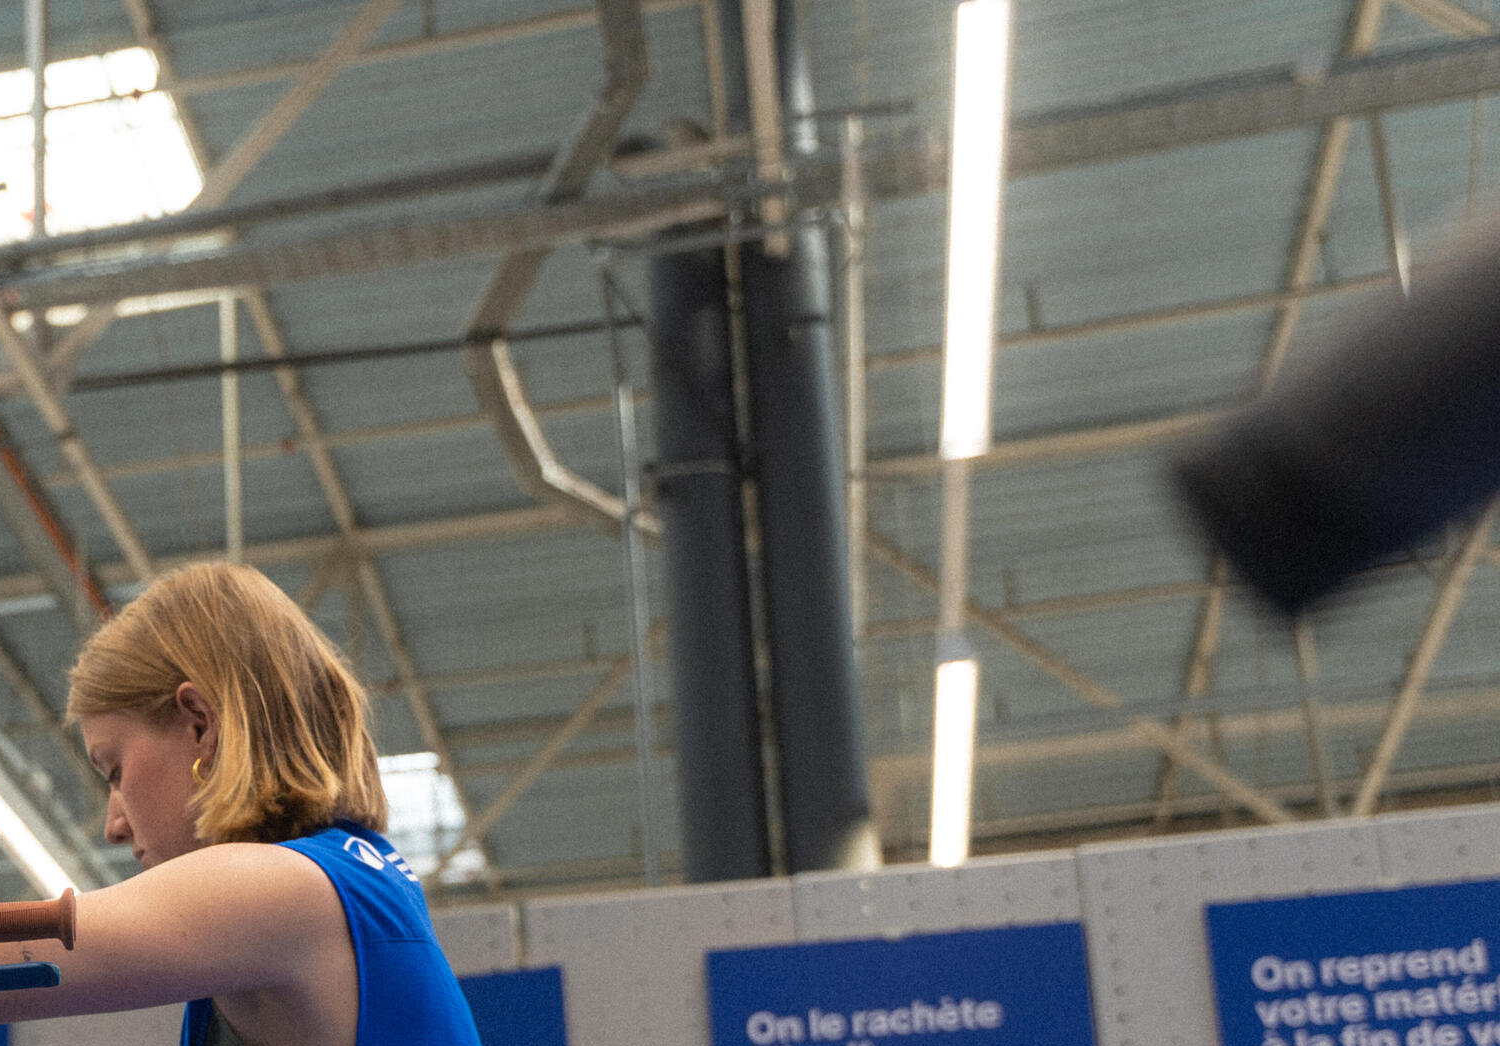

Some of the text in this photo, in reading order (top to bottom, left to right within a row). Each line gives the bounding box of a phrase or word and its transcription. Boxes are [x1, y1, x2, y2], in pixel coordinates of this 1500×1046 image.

[1251, 938, 1489, 992] On reprend
[746, 995, 1004, 1046] On le rachète
[1255, 974, 1500, 1029] votre matér
